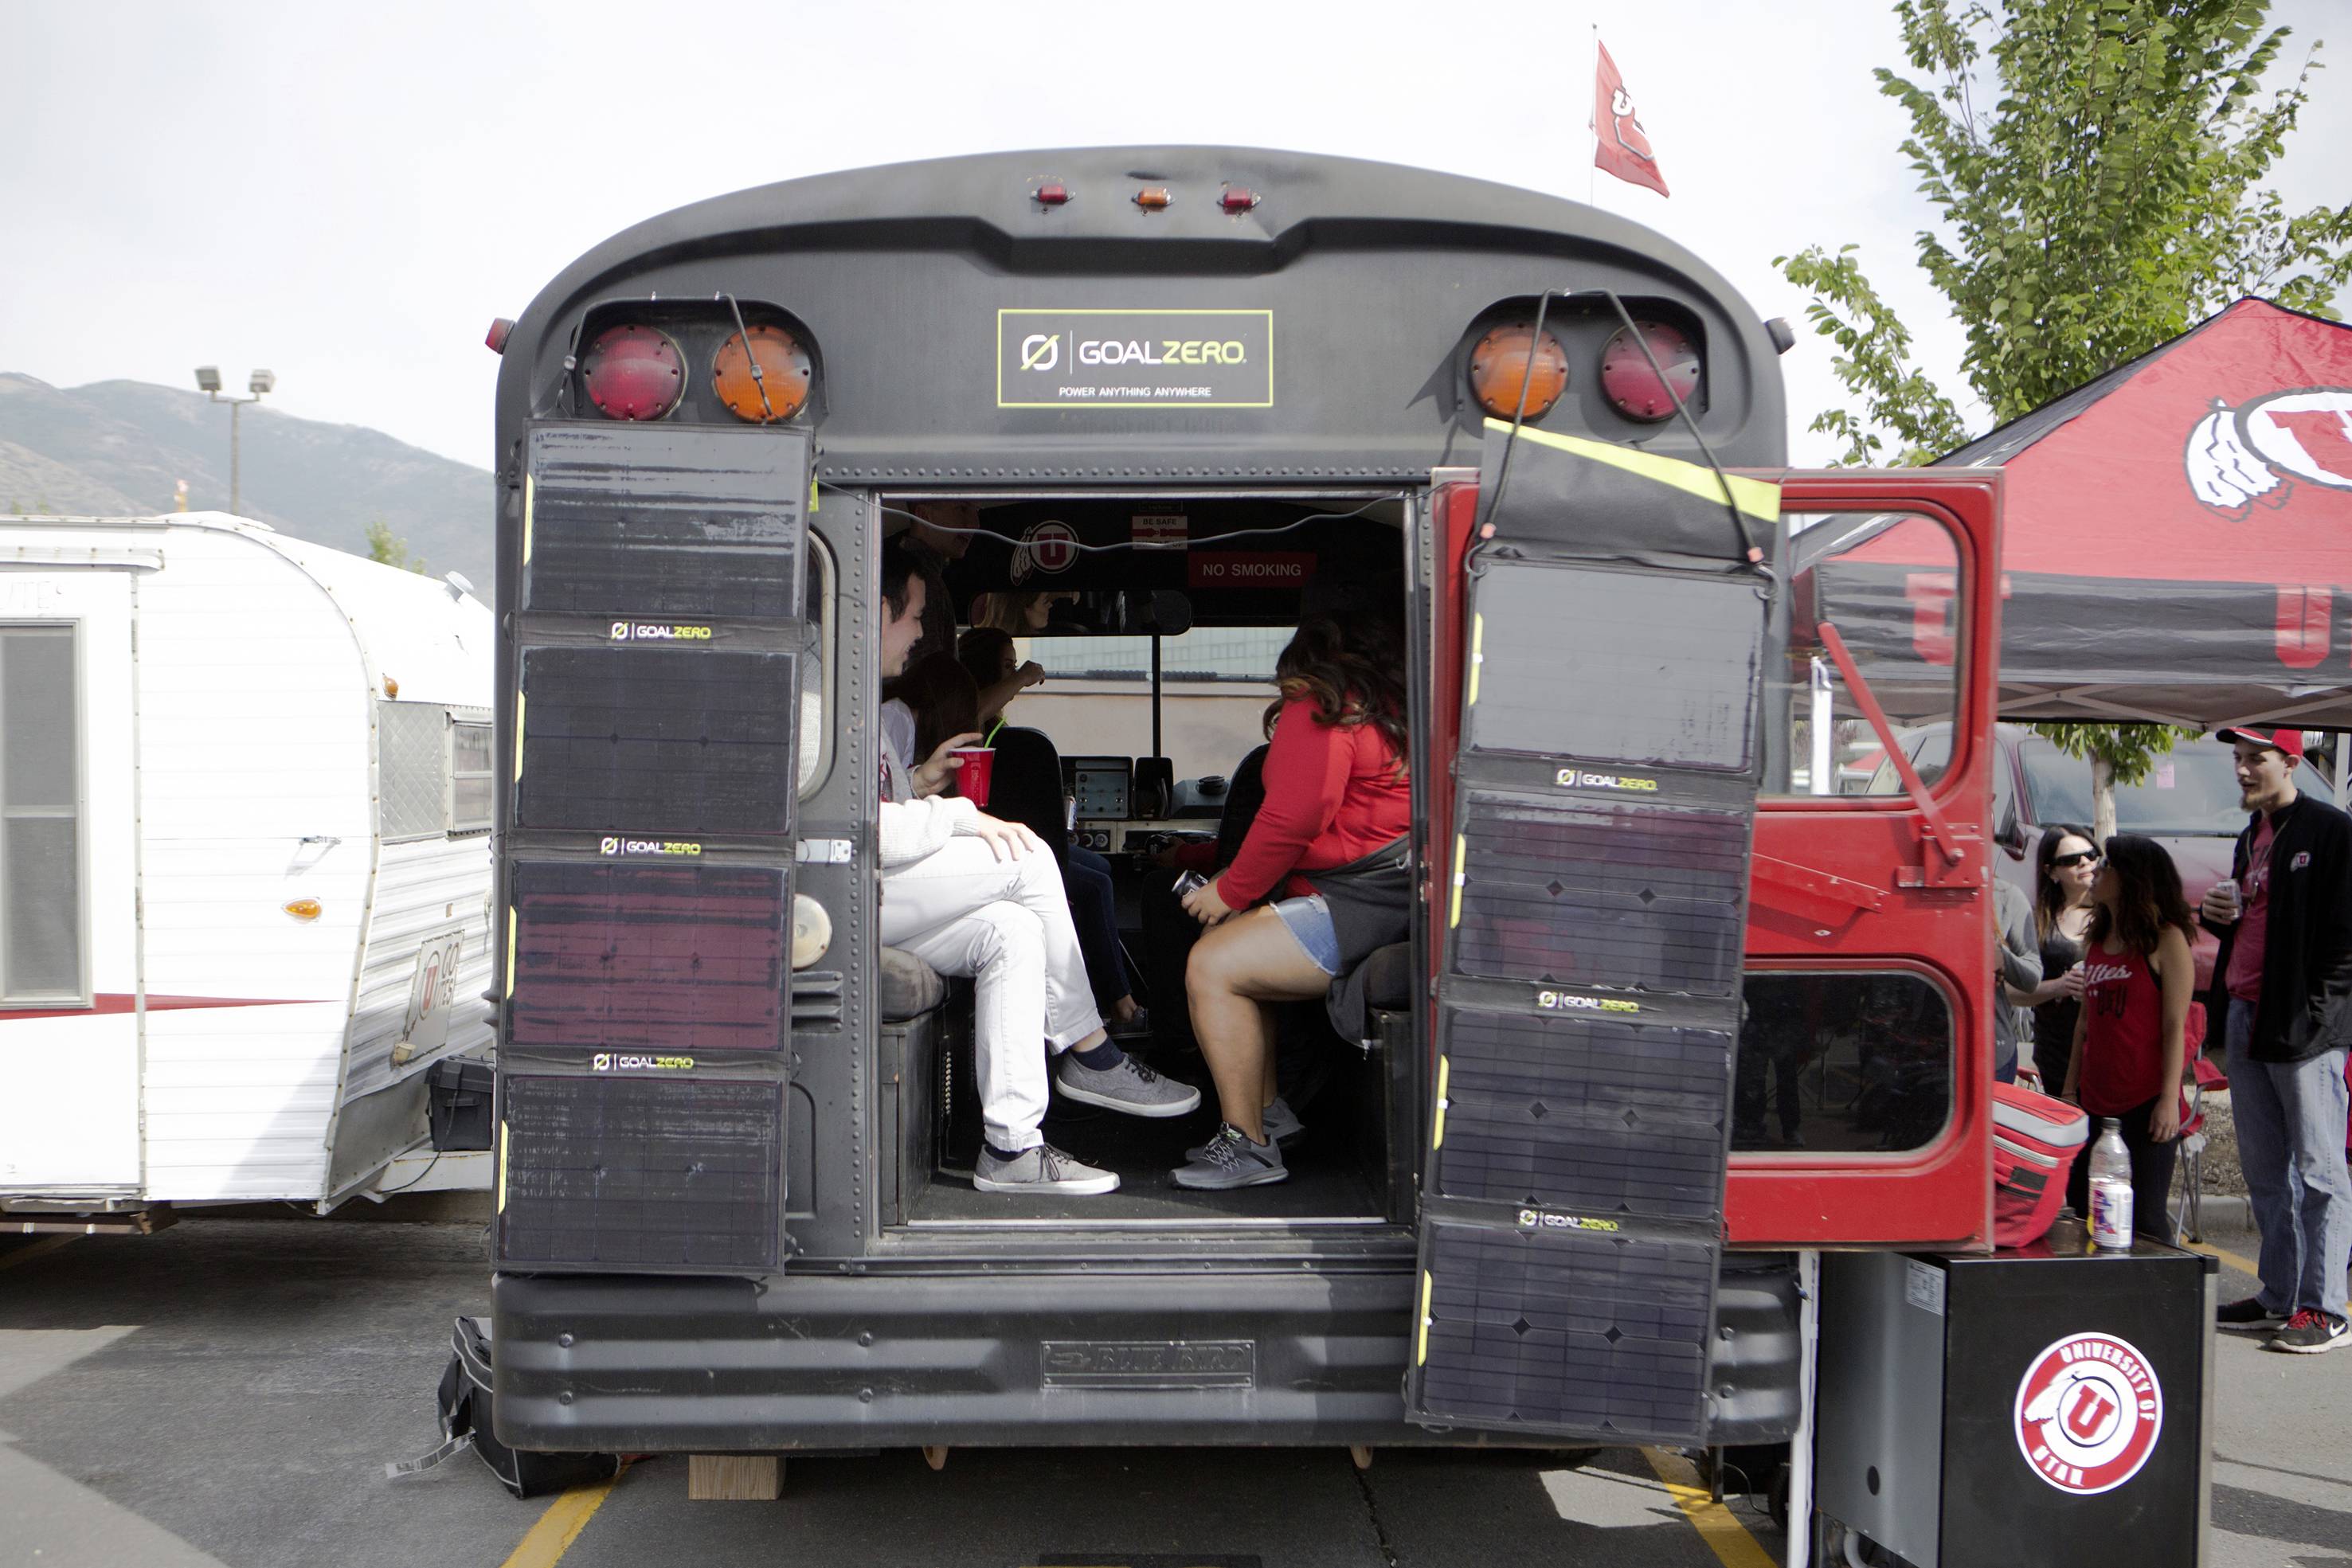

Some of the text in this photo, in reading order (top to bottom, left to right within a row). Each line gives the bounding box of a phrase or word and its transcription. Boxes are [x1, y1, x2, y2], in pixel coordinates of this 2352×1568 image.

[1059, 387, 1211, 397] POWER ANYTHING ANYWHERE
[1203, 564, 1301, 577] NO SMOKING
[2060, 1342, 2152, 1393] UNIVERSITY
[2068, 1384, 2115, 1439] U
[2033, 1445, 2084, 1487] UTAH
